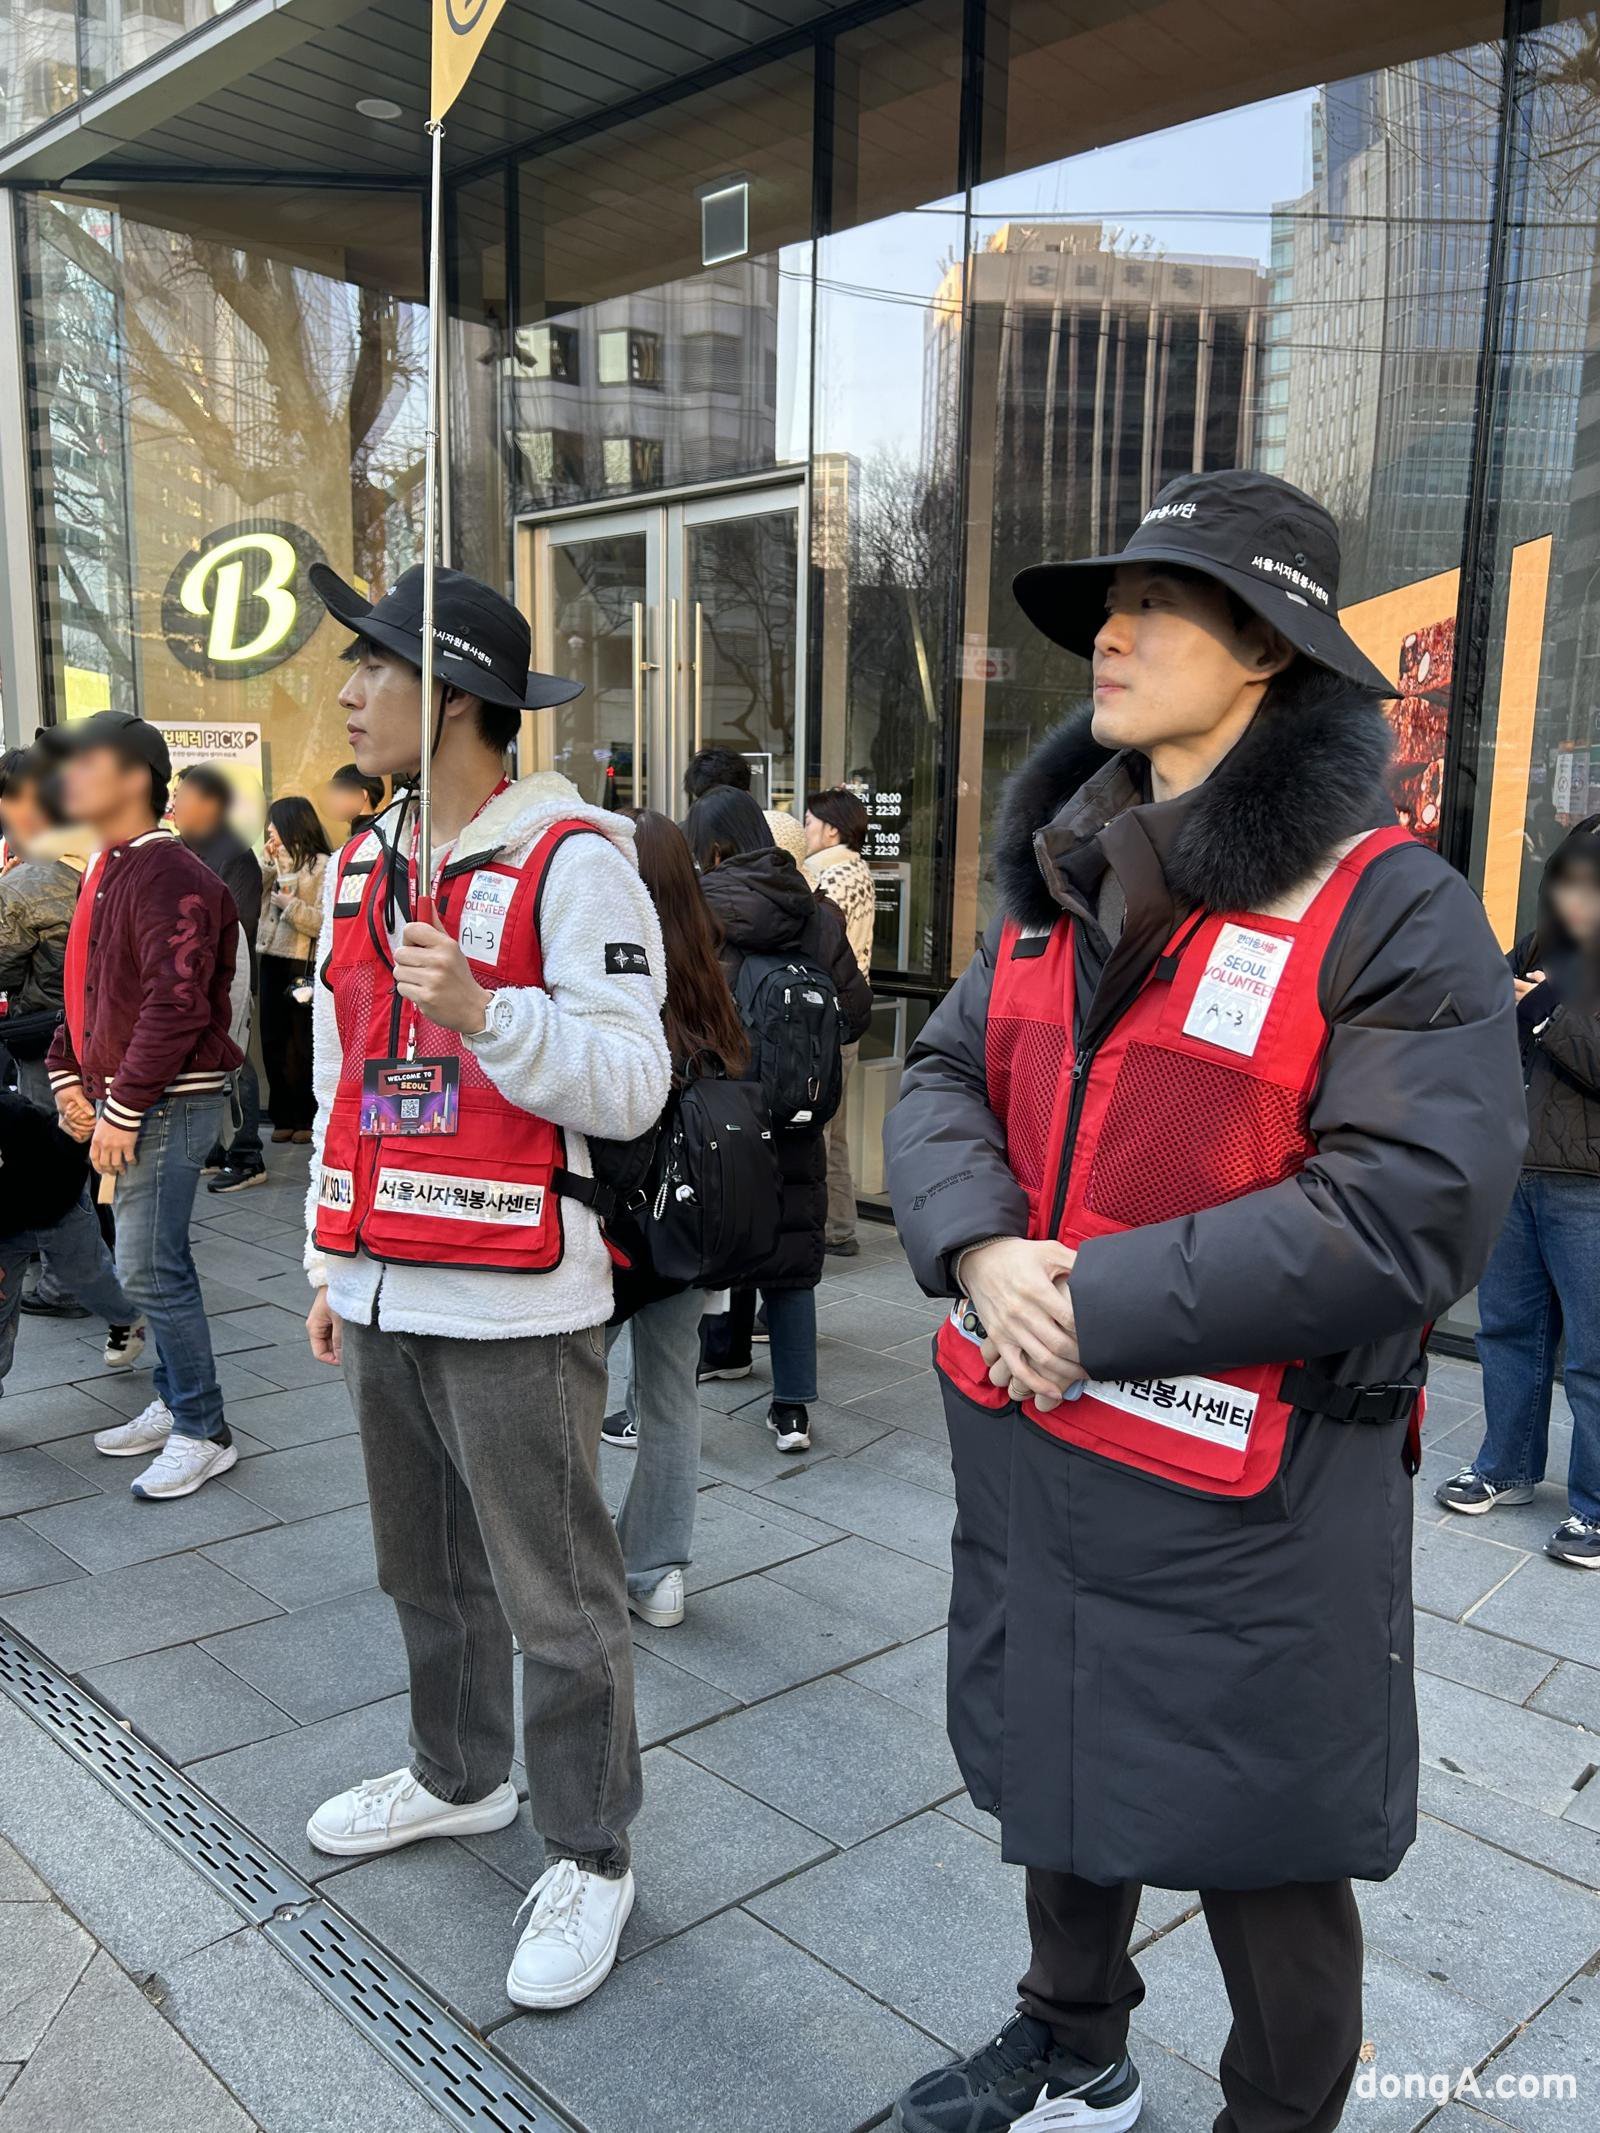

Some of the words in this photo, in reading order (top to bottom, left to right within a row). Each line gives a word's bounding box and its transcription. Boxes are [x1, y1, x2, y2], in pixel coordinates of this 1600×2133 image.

[1252, 555, 1329, 605] 서울시자원봉사센터
[180, 533, 296, 661] B
[205, 731, 242, 748] PICK
[876, 792, 902, 804] 08:00
[876, 805, 901, 816] 22:30
[875, 832, 900, 844] 10:00
[874, 845, 900, 856] 22:30
[471, 890, 500, 904] SEOUL
[465, 901, 507, 917] OLUNTEE
[1223, 954, 1268, 980] SEOUL
[387, 1073, 421, 1083] WELCOME
[423, 1071, 432, 1079] TO
[400, 1081, 429, 1091] SEOUL
[378, 1179, 542, 1215] 서울시자원봉사센터
